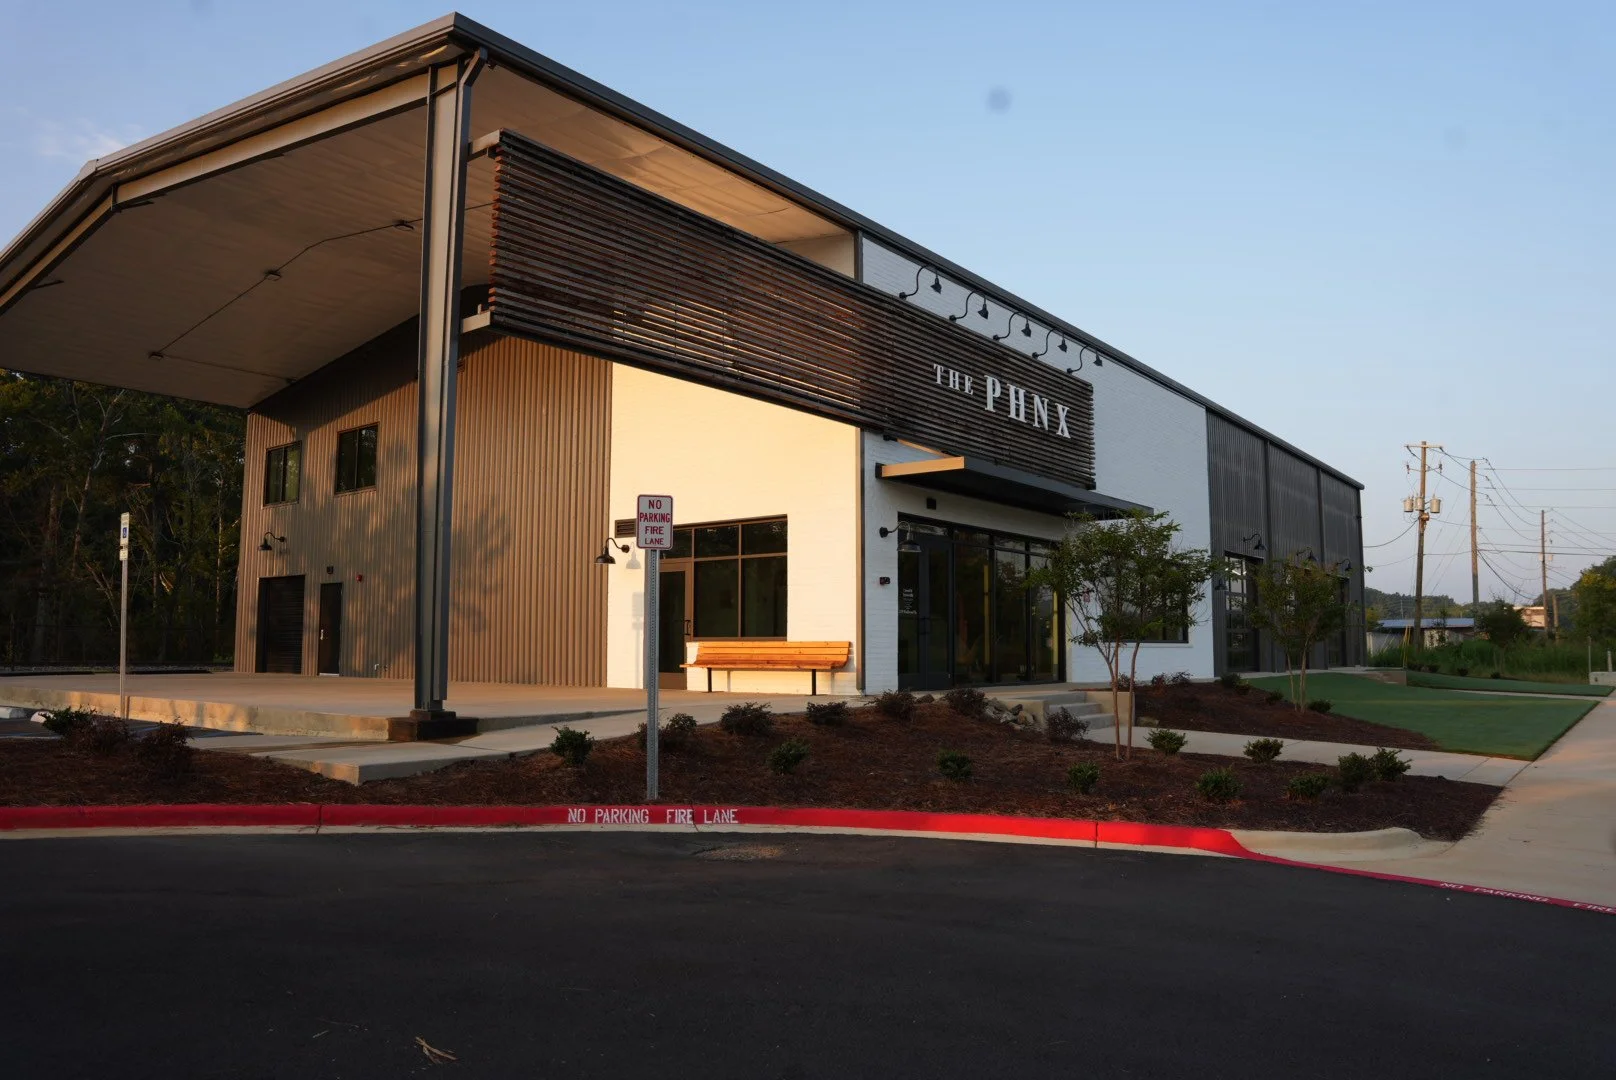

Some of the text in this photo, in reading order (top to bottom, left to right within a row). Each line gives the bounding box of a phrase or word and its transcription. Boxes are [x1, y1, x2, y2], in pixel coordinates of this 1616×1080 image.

[933, 363, 1071, 439] THE PHNX
[648, 499, 662, 510] NO
[639, 512, 670, 523] PARKING
[644, 525, 664, 535] FIRE
[567, 808, 738, 824] NO PARKING FIRE LANE
[1473, 887, 1549, 902] PARKING
